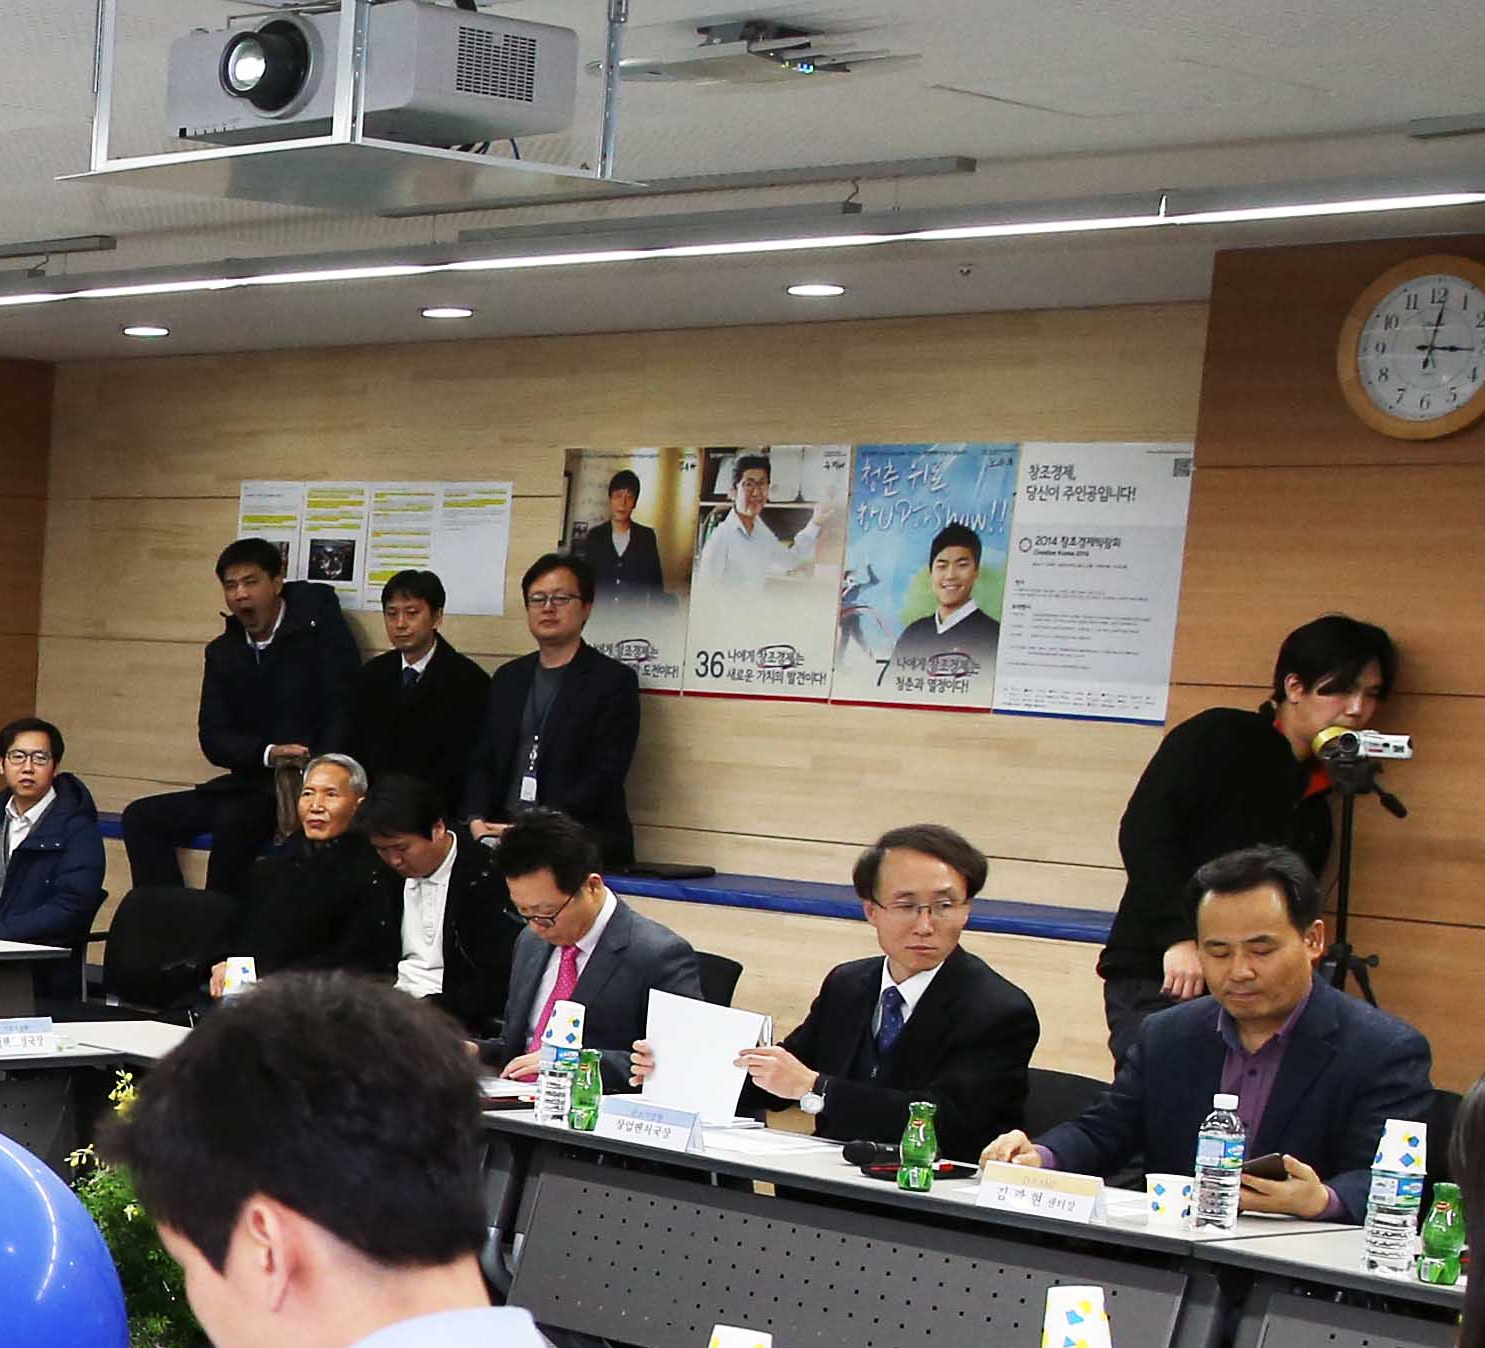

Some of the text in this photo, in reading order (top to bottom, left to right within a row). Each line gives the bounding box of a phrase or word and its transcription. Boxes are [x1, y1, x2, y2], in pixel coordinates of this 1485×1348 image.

[1405, 294, 1418, 310] 11
[1430, 288, 1448, 304] 12
[1462, 294, 1469, 310] 1
[1384, 315, 1399, 330] 10
[1376, 342, 1386, 355] 9
[1379, 367, 1388, 382] 8
[1468, 366, 1477, 382] 4
[1396, 388, 1405, 404] 7
[1420, 394, 1430, 409] 6
[1446, 387, 1458, 402] 5
[1026, 485, 1136, 503] 당신이 주인공입니다!
[695, 651, 724, 678] 36
[875, 660, 890, 686] 7
